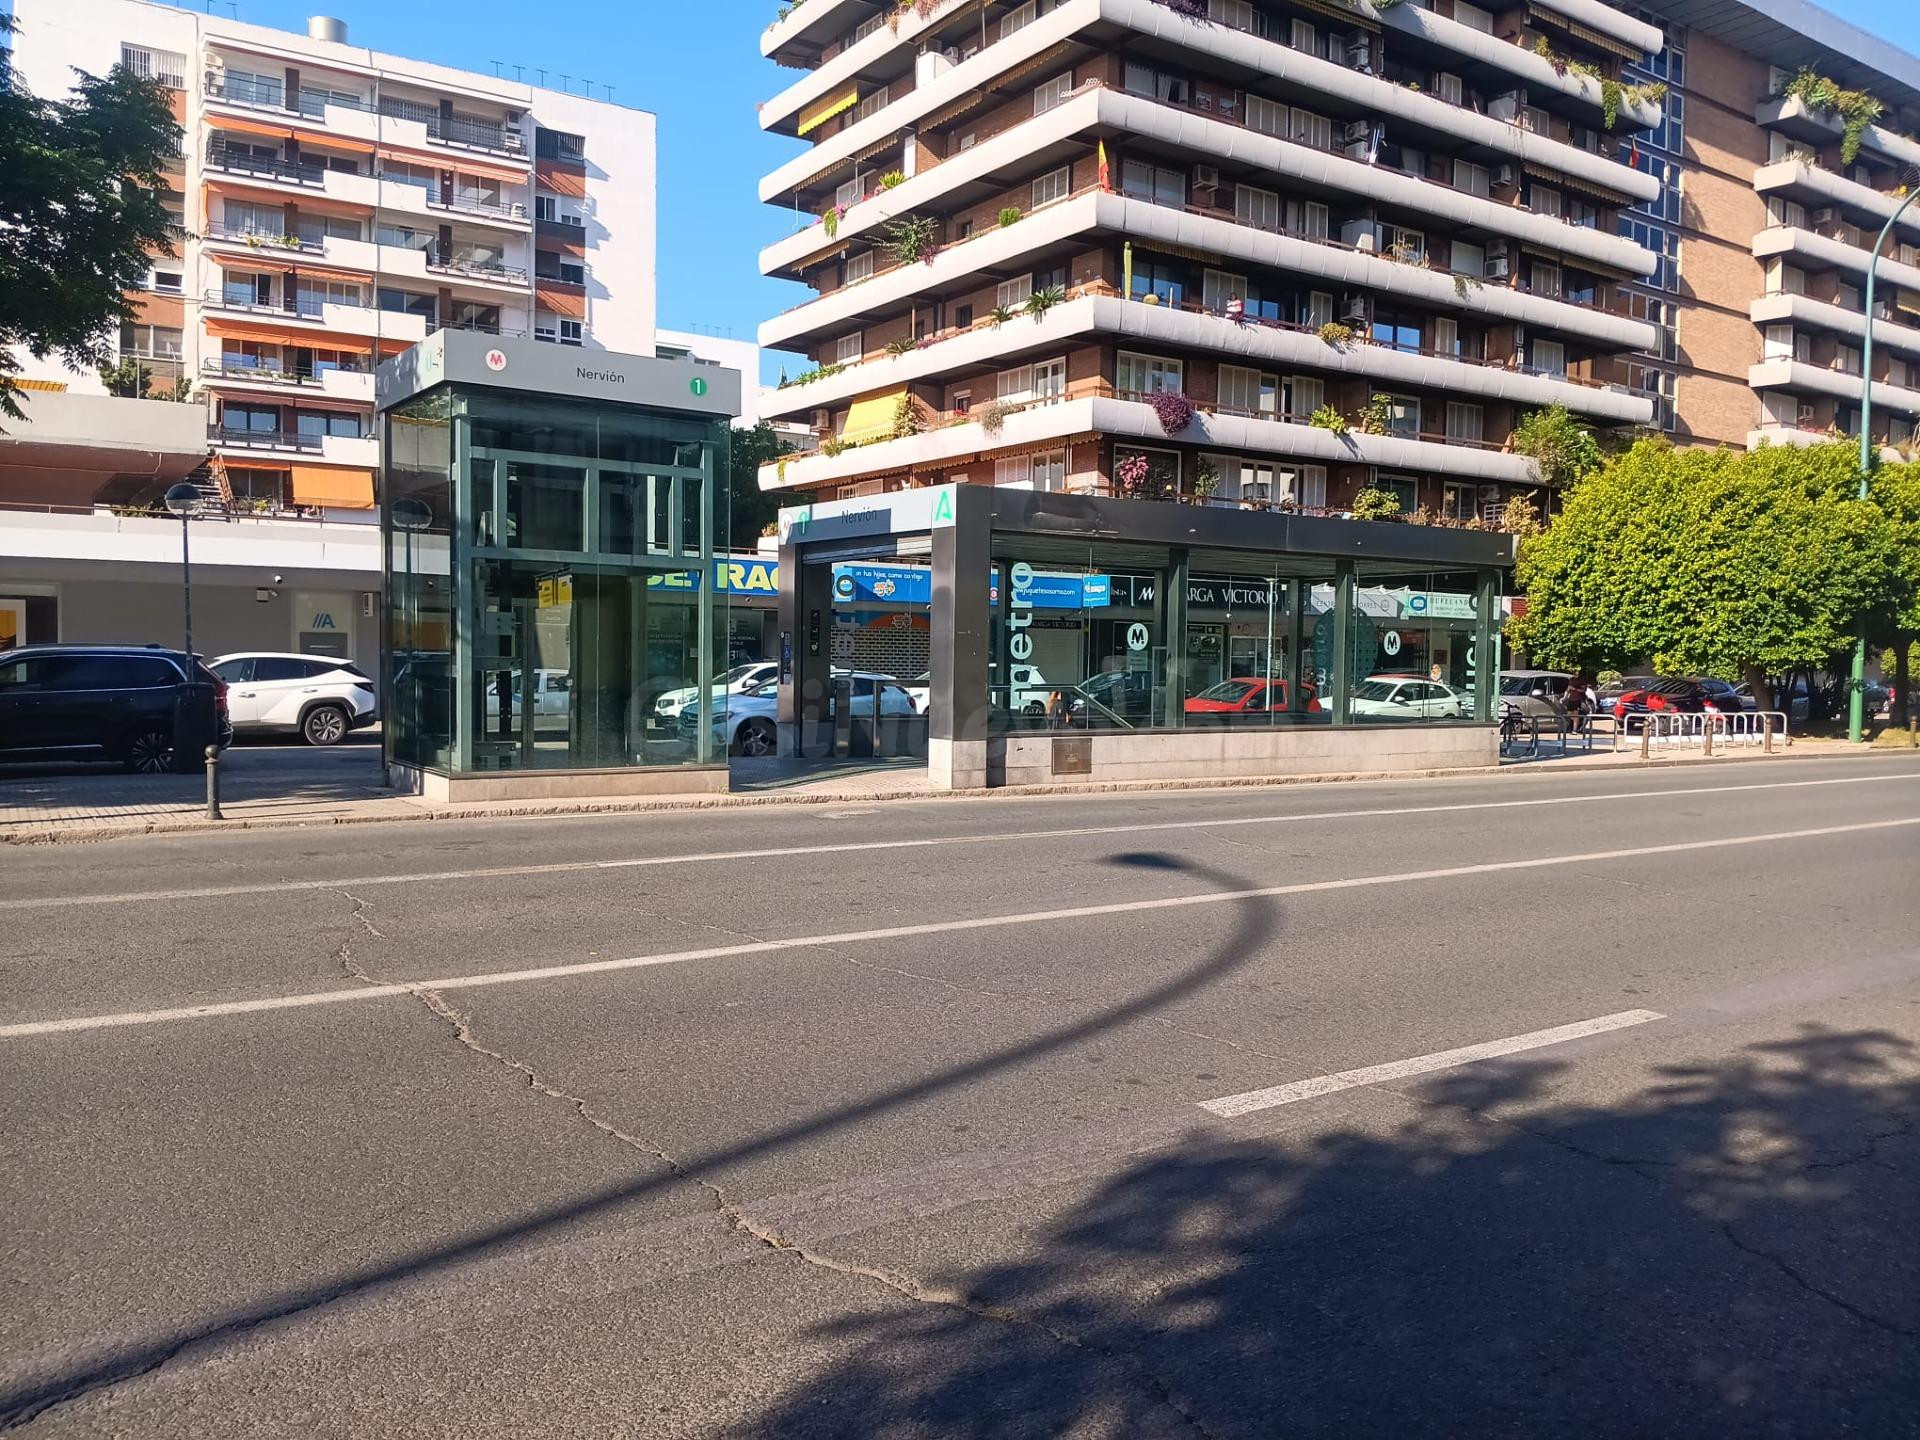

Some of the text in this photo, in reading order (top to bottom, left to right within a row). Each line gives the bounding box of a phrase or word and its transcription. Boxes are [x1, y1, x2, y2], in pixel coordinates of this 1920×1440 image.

[576, 366, 625, 384] Nervión
[935, 490, 952, 522] A
[841, 506, 878, 525] Nervión
[1222, 588, 1279, 605] VICTORIO
